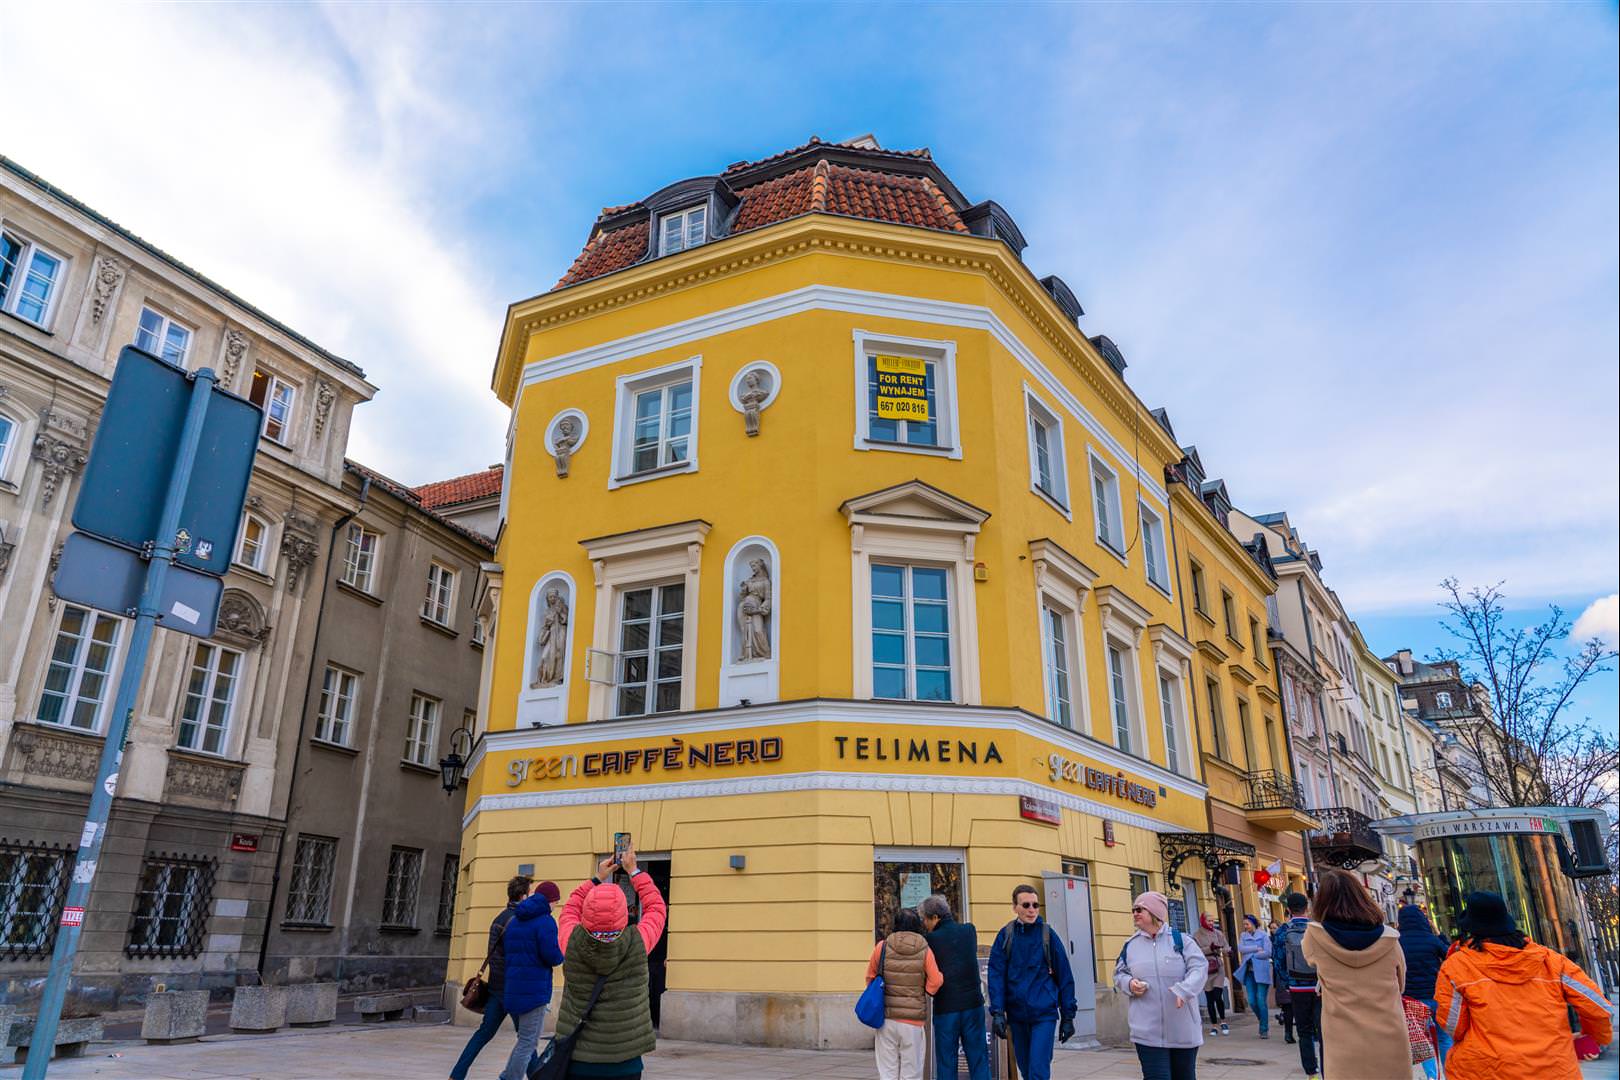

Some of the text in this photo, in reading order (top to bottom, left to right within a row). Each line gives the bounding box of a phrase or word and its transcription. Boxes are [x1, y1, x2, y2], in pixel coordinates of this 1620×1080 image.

[879, 375, 924, 386] FOR RENT
[879, 385, 925, 397] WYNAJEM
[880, 401, 925, 414] 667 020 816
[834, 736, 1003, 764] TELIMENA
[507, 737, 783, 786] green CAFFÈ NERO
[1127, 779, 1157, 808] NERO
[1453, 820, 1519, 832] WARSZAWA
